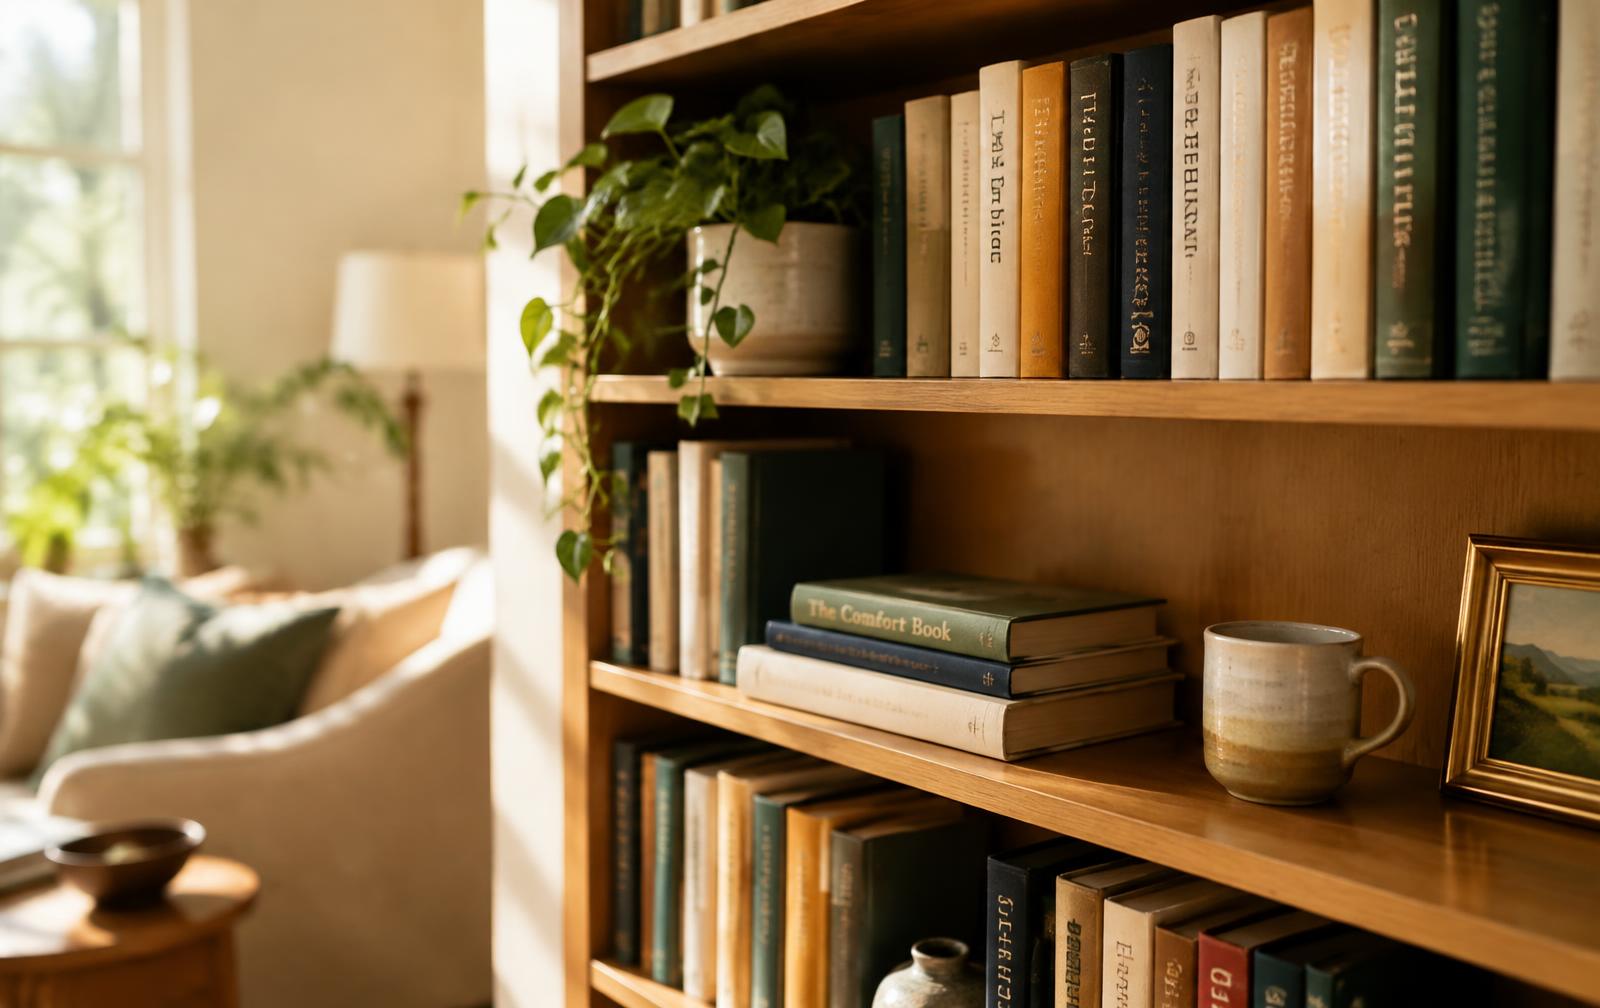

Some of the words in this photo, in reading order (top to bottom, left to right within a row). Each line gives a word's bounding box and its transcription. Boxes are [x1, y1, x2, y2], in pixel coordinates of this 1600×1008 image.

[809, 600, 836, 621] The
[841, 604, 906, 632] Comfort
[912, 618, 951, 641] Book
